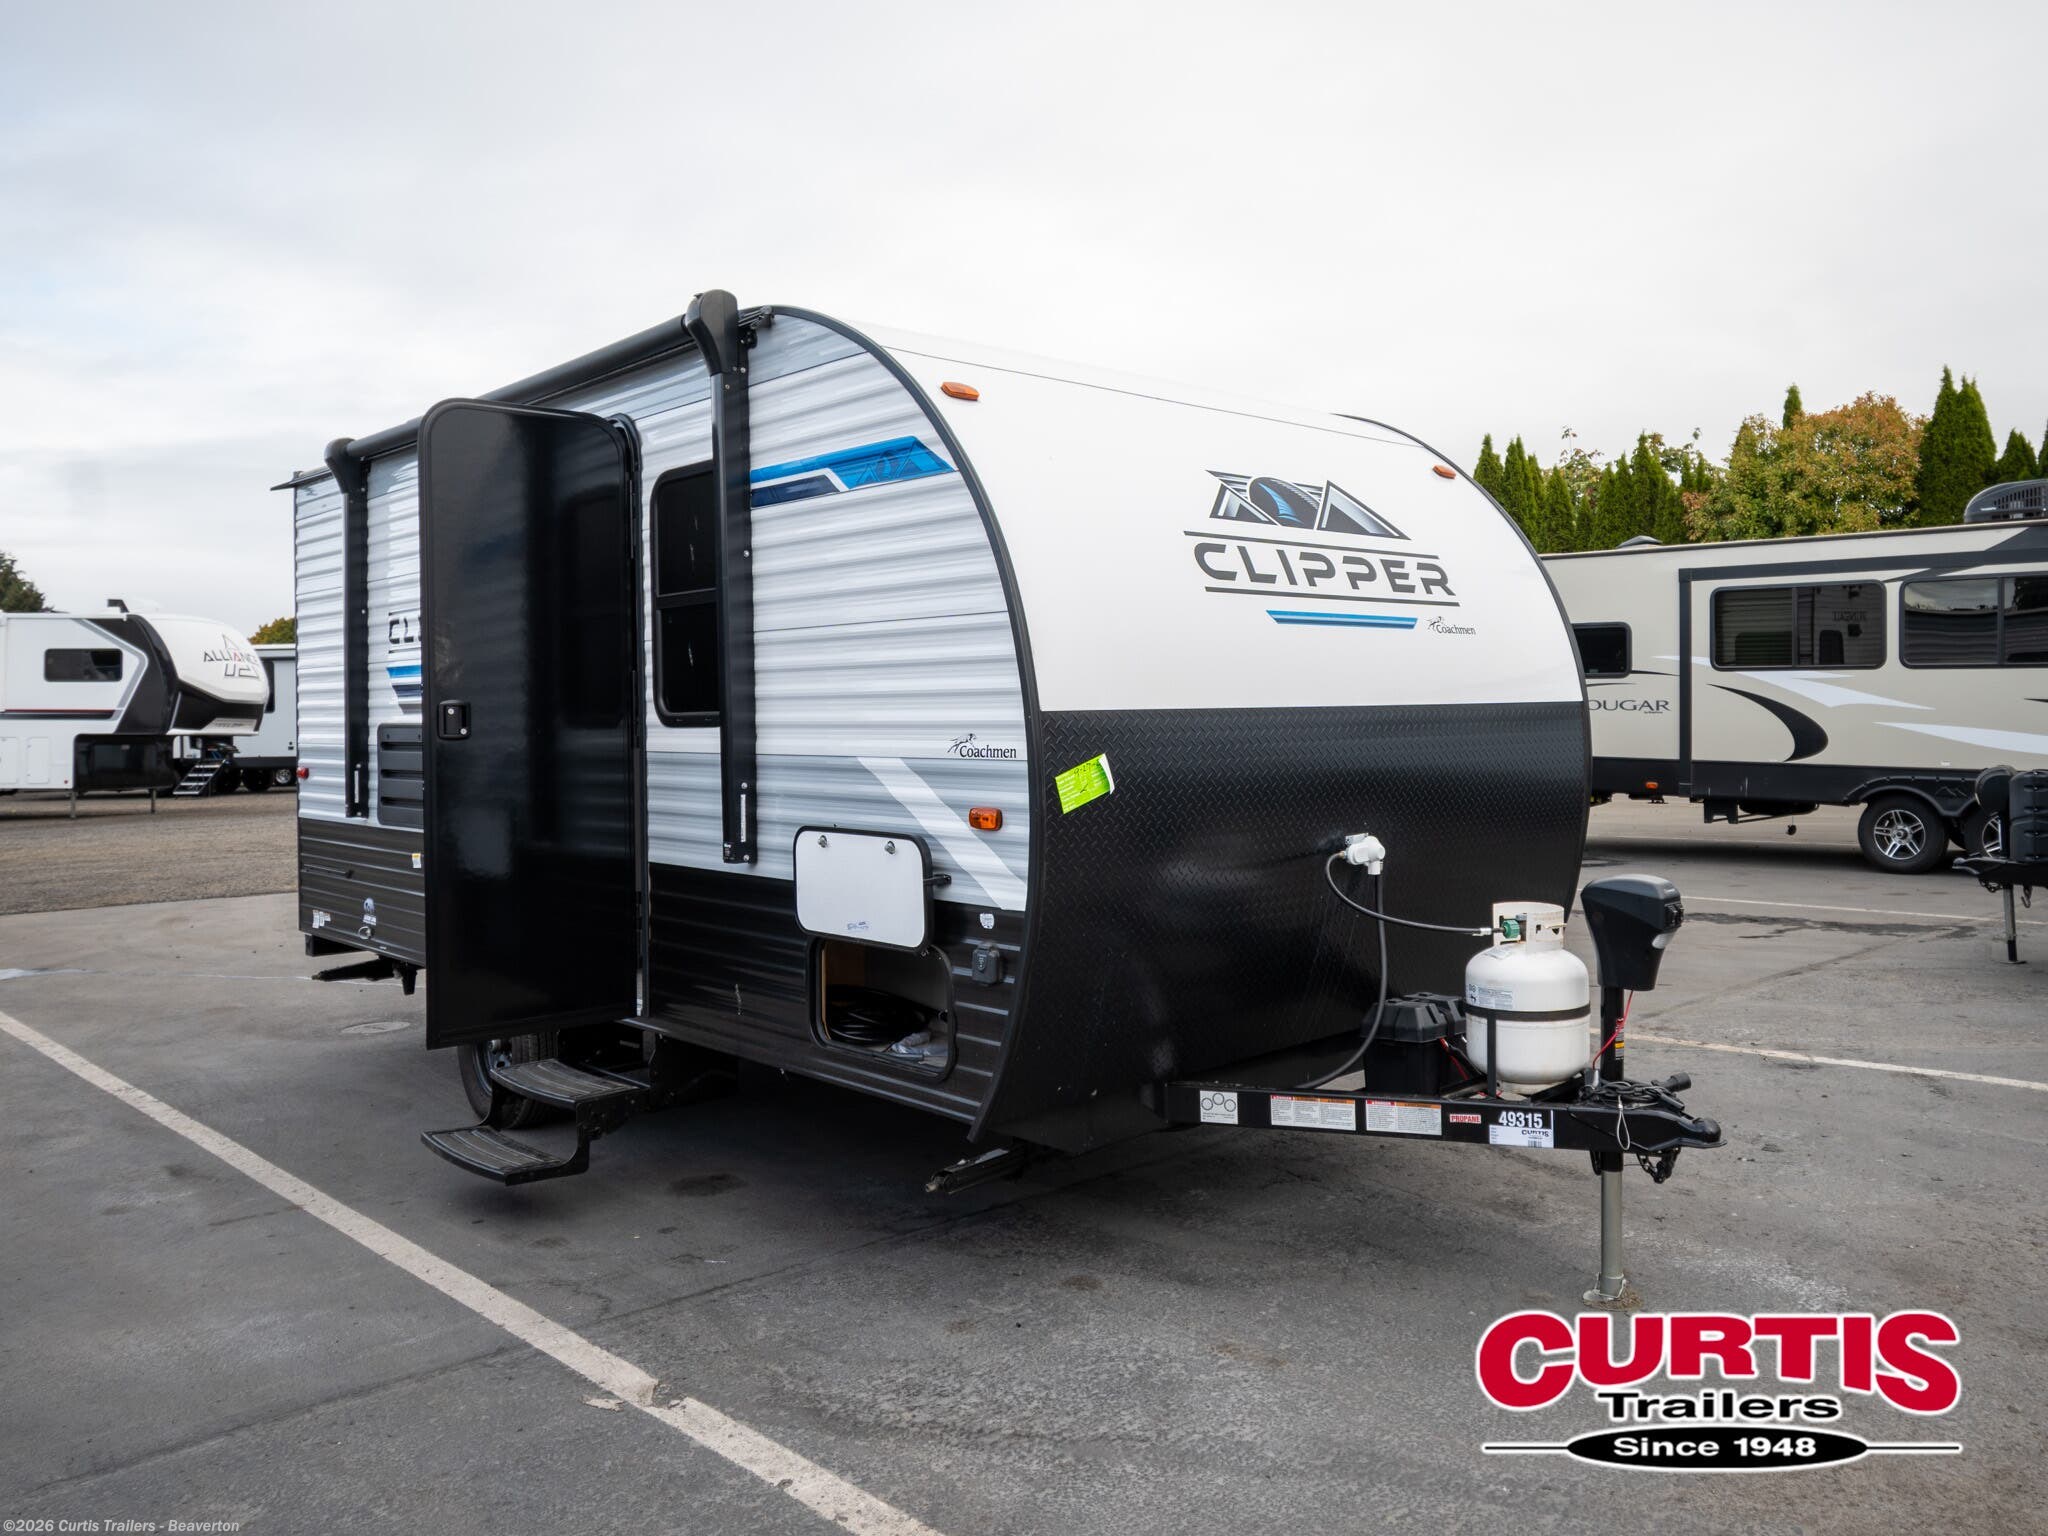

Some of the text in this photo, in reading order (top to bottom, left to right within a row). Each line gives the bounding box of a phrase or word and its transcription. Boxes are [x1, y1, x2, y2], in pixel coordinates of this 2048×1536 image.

[1194, 542, 1456, 597] CLIPPER
[1436, 624, 1476, 635] Coachmen
[1588, 699, 1671, 711] OUGAR
[959, 744, 1017, 759] Coachmen
[1451, 1115, 1481, 1123] PROPANE
[1499, 1111, 1543, 1129] 49315
